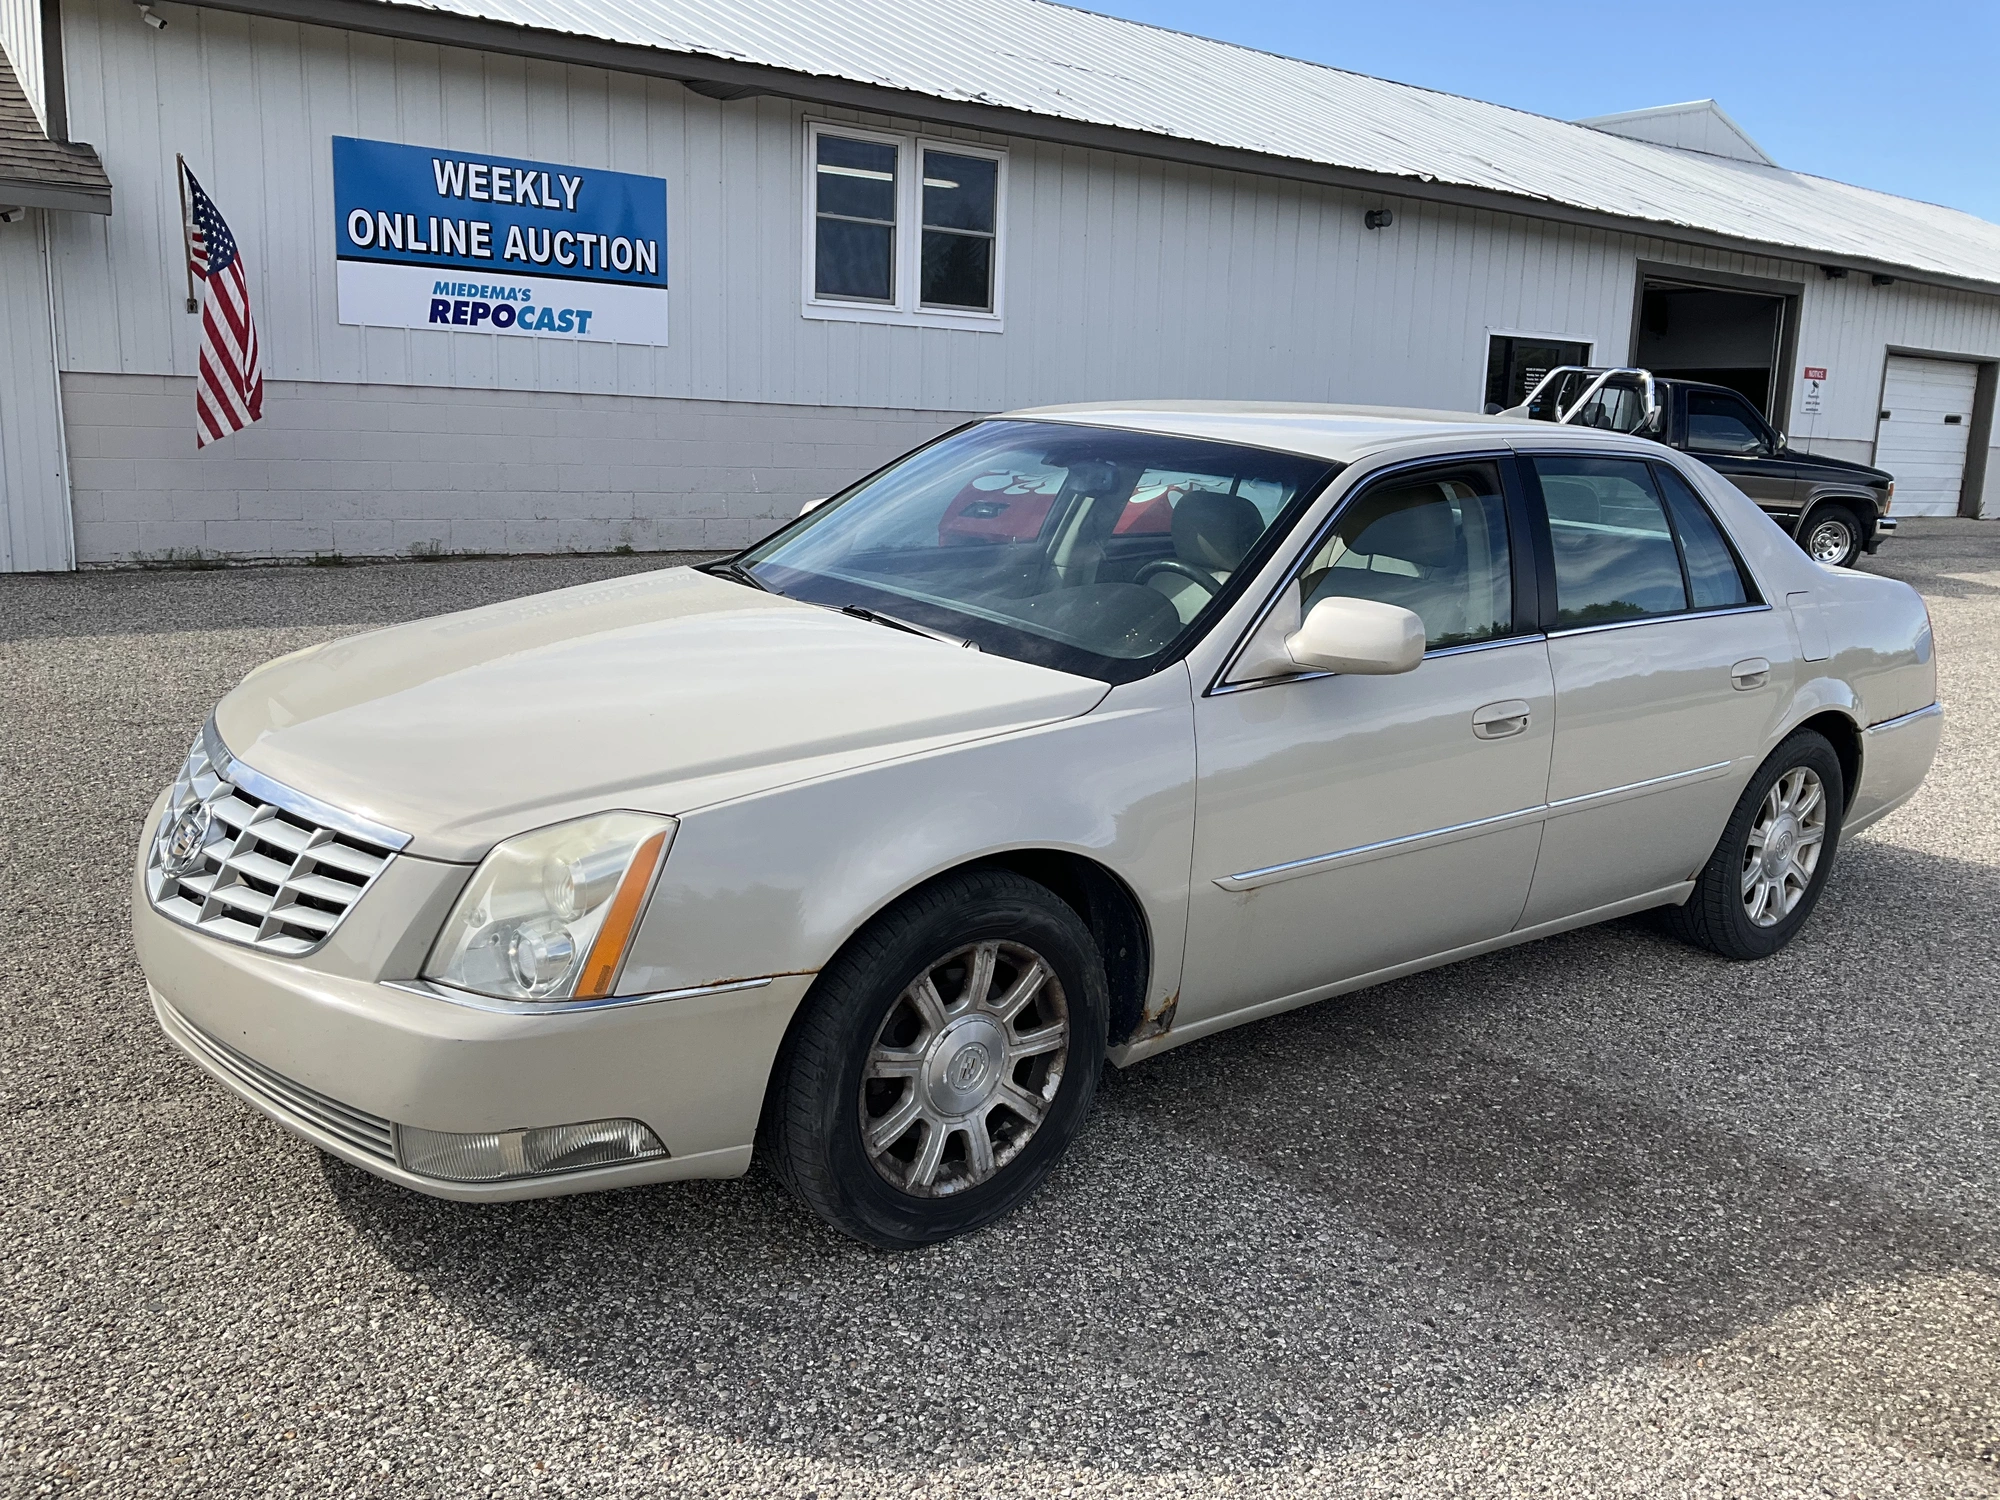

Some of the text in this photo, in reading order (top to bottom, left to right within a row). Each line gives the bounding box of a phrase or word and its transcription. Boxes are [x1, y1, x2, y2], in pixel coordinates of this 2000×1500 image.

[432, 158, 583, 211] WEEKLY
[347, 208, 658, 275] ONLINE AUCTION
[432, 281, 531, 301] MIEDEMA'S
[429, 298, 592, 334] REPOCAST
[1808, 370, 1824, 378] NOTICE
